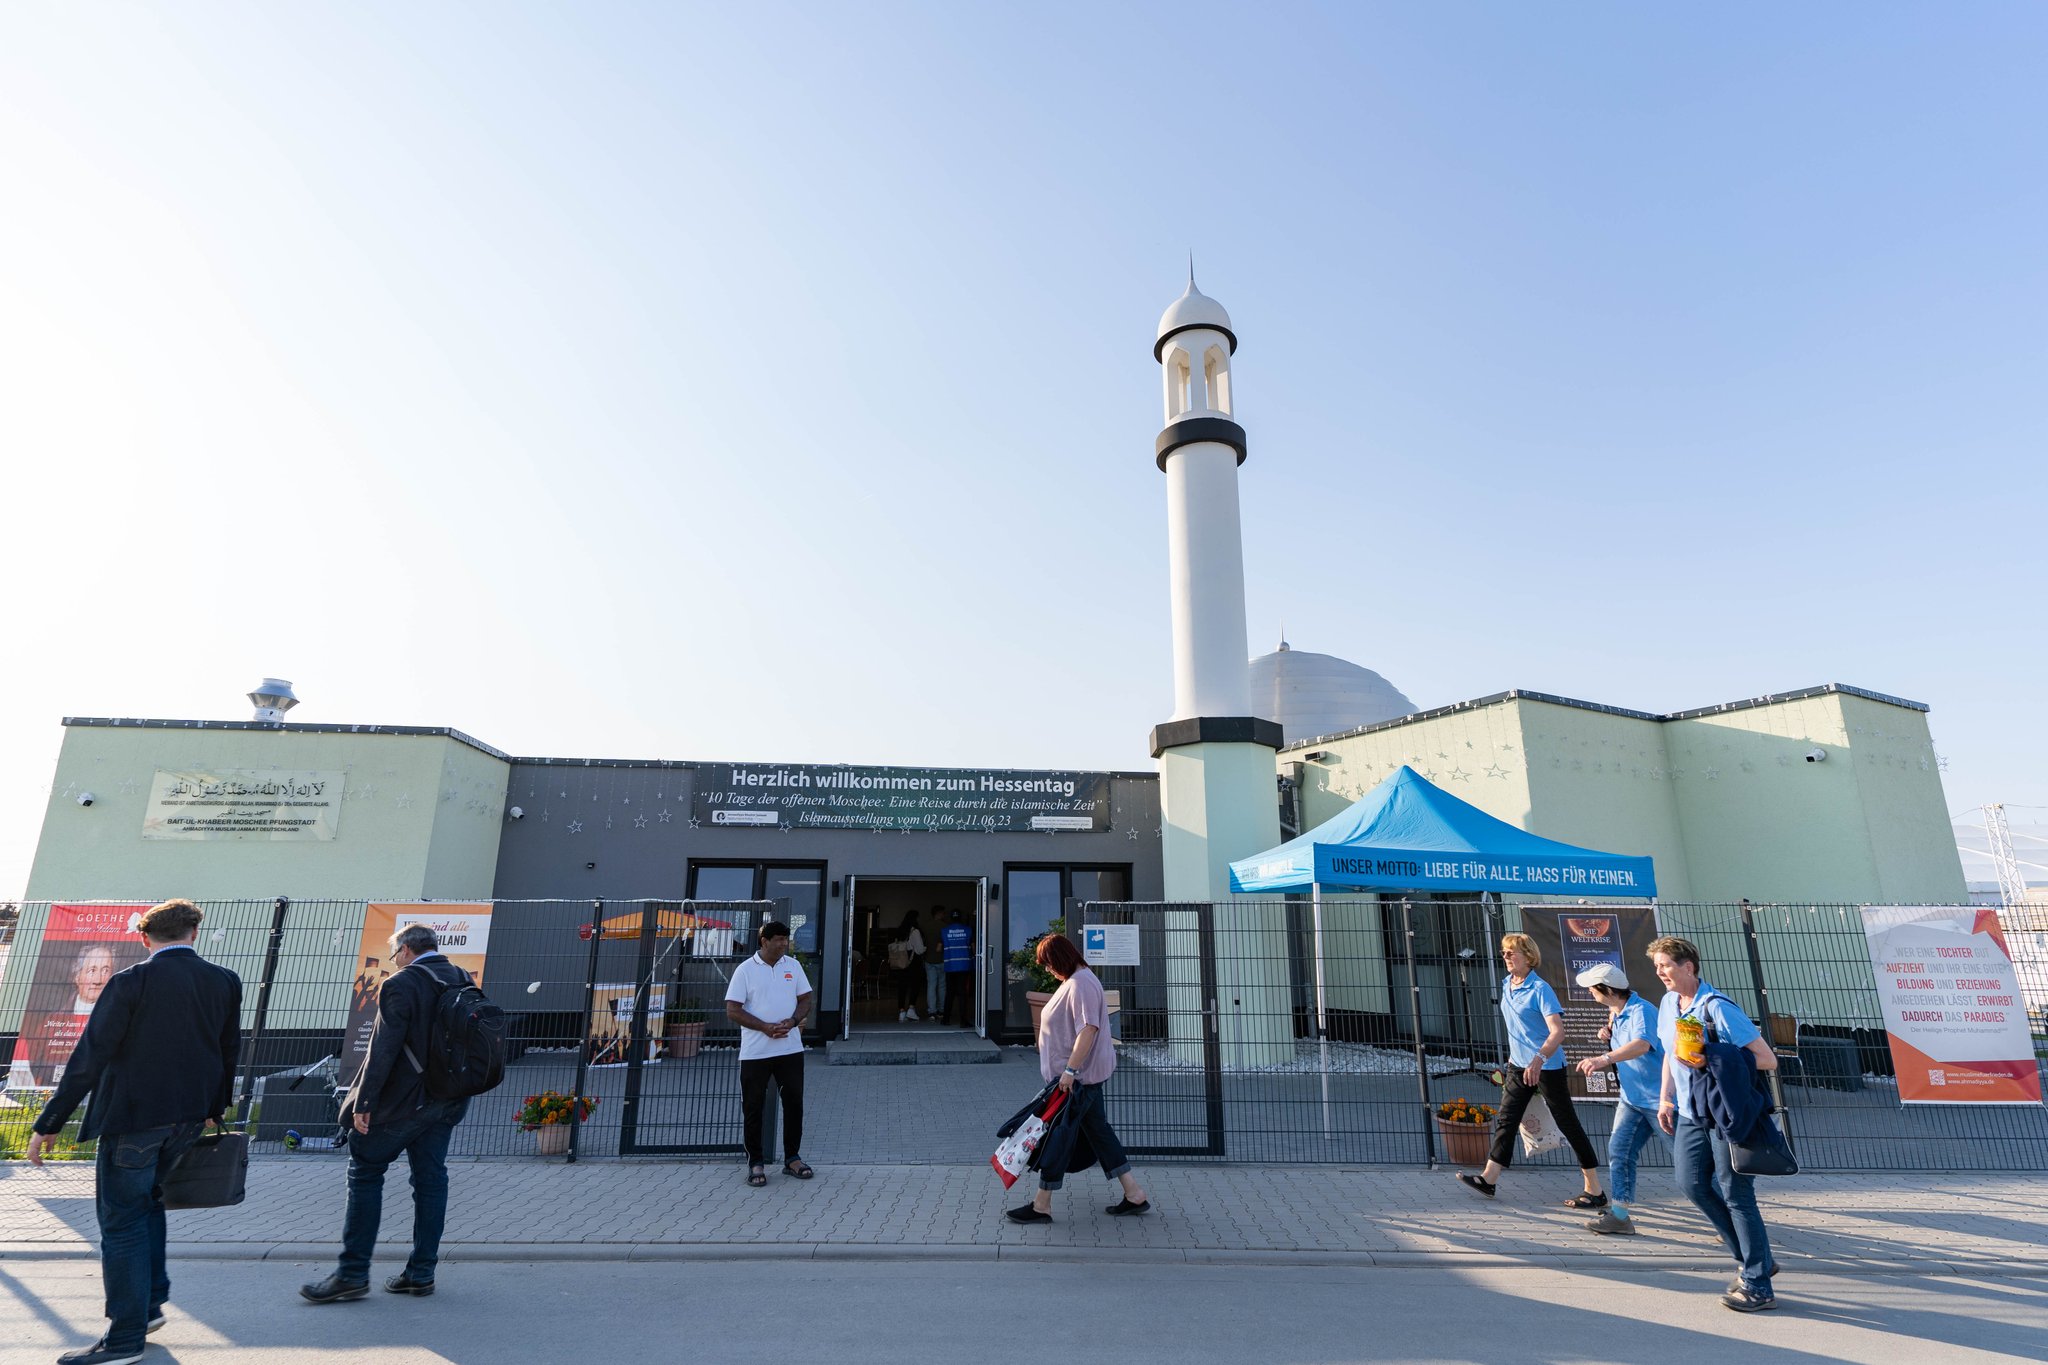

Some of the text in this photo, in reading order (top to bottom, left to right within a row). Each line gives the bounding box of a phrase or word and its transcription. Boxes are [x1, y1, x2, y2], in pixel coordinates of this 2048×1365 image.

[732, 769, 1075, 797] Herzlich willkommen zum Hessentag
[726, 792, 754, 806] Tage
[758, 793, 778, 804] der
[781, 793, 826, 807] offenen
[829, 795, 885, 807] Moschee:
[889, 796, 916, 807] Eine
[920, 797, 950, 809] Reise
[954, 797, 984, 809] durch
[988, 798, 1008, 810] die
[1010, 798, 1070, 811] islamische
[1073, 799, 1103, 811] Zeit”
[799, 811, 893, 826] Islamausstellung
[897, 816, 920, 825] vom
[923, 814, 954, 826] 02.06
[966, 814, 1011, 826] 11.06.23
[1332, 857, 1638, 887] UNSER MOTTO: LIEBE FÜR ALLE, HASS FÜR KEINEN.
[77, 914, 125, 923] GOETHE
[93, 923, 121, 933] Islam
[450, 921, 470, 932] alle
[1916, 947, 1935, 958] EINE
[1936, 947, 1974, 958] TOCHTER
[1974, 948, 1989, 958] GUT
[1886, 963, 2004, 974] AUFZIEHT UND IHR EINE GUTE
[1896, 979, 2001, 990] BILDUNG UND ERZIEHUNG
[1891, 995, 1946, 1006] ANGEDEIHEN
[1977, 995, 2014, 1006] ERWIRBT
[1902, 1011, 1943, 1022] DADURCH
[1945, 1011, 1962, 1022] DAS
